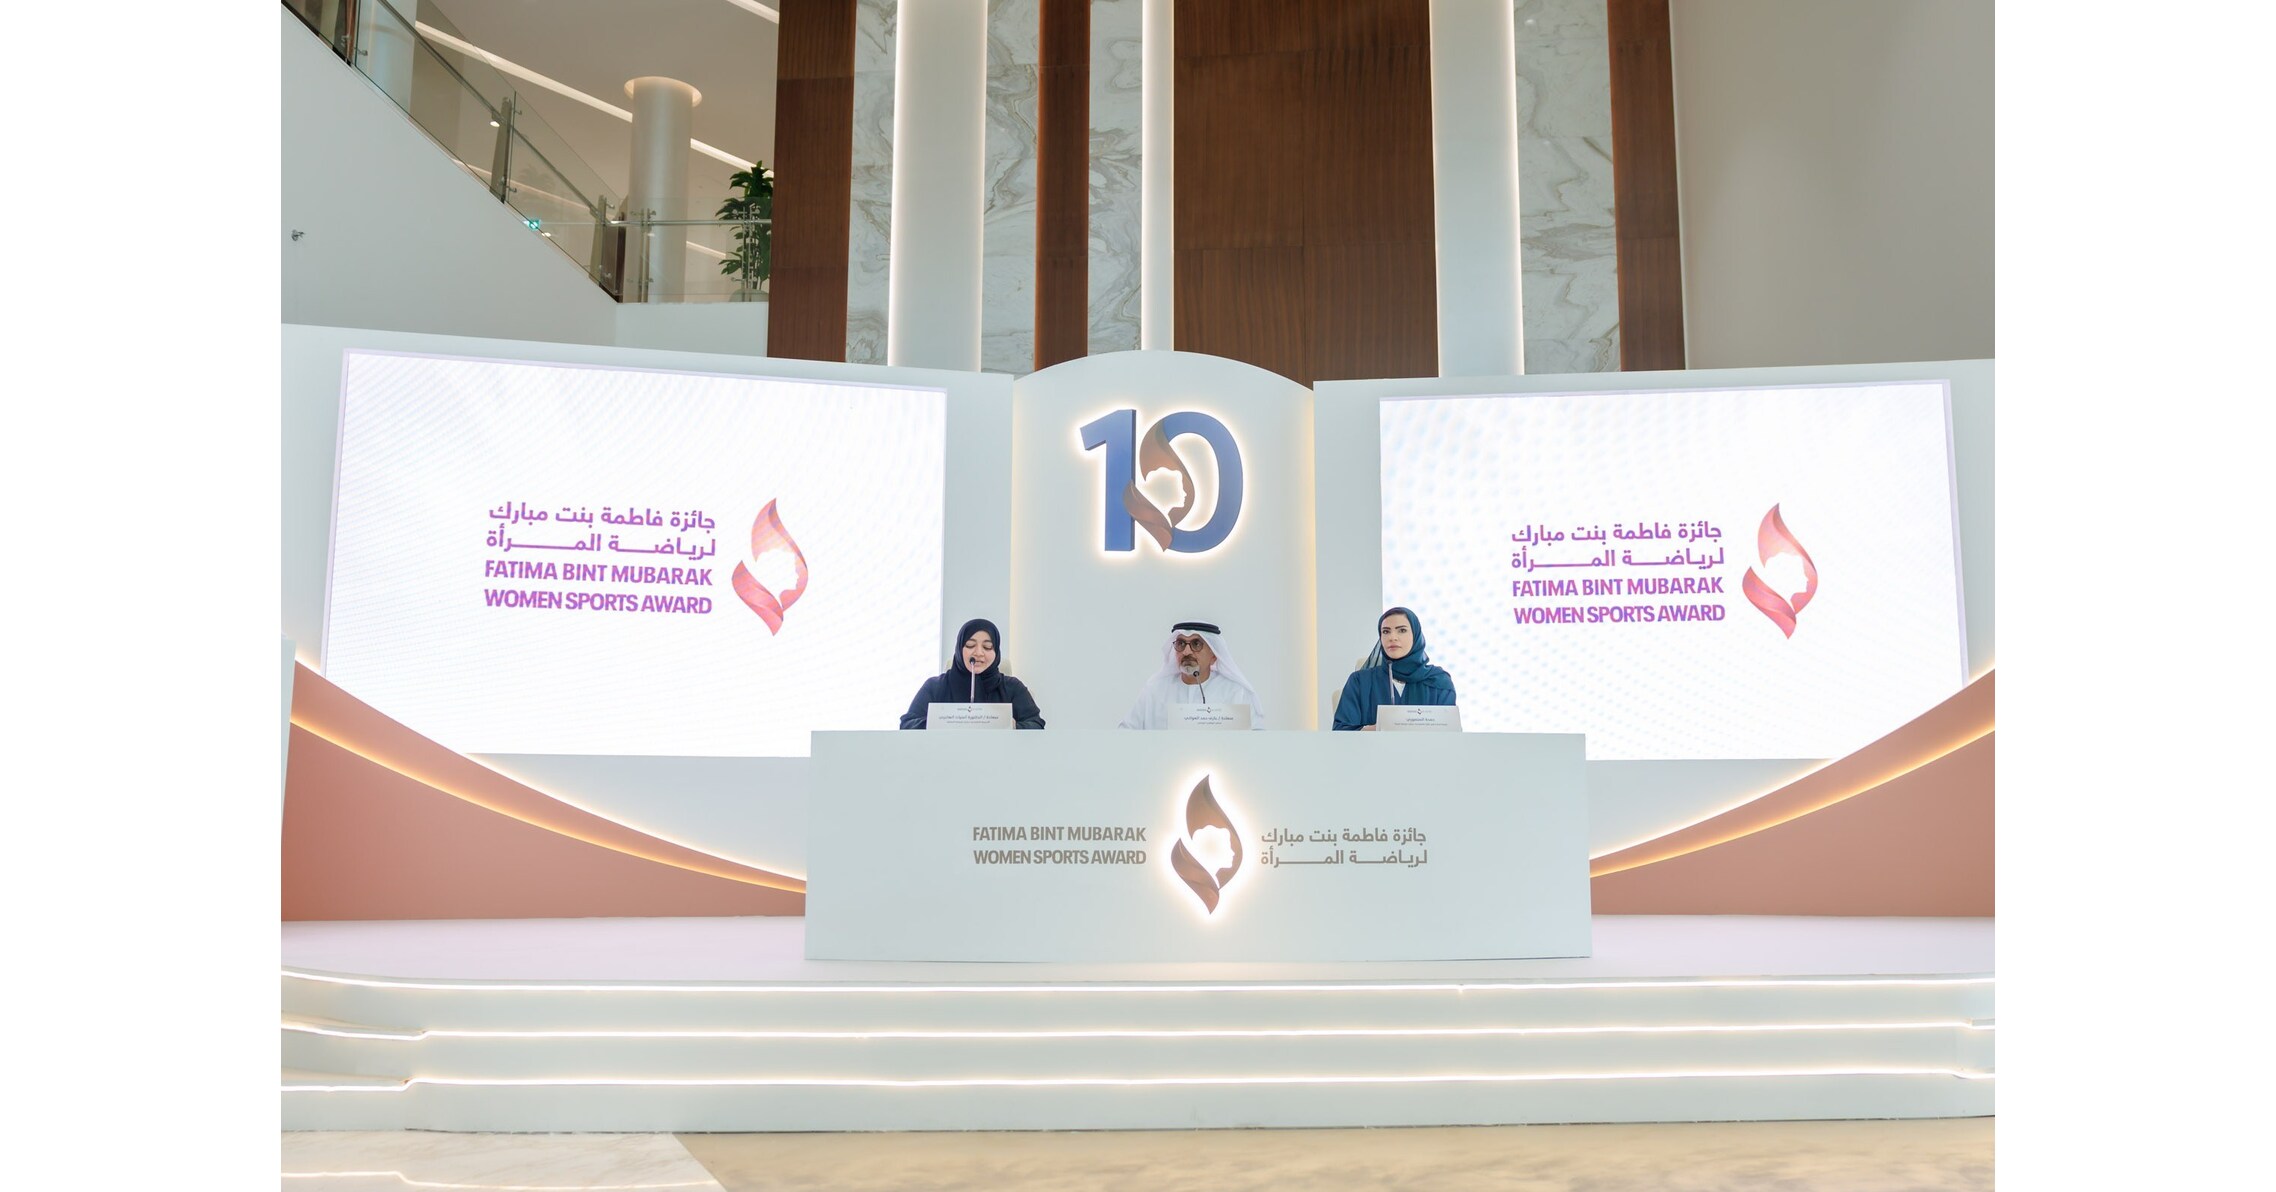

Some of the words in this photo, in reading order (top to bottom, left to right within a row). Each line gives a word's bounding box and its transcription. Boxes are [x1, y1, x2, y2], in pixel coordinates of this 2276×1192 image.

[489, 501, 548, 525] مبارك
[555, 506, 594, 528] بنت
[601, 506, 663, 527] فاطمة
[670, 510, 716, 534] جائزة
[1511, 524, 1565, 547] مبارك
[1571, 526, 1607, 545] بنت
[1613, 522, 1672, 541] فاطمة
[1678, 520, 1722, 544] جائزة
[484, 560, 558, 581] FATIMA
[562, 563, 607, 582] BINT
[611, 564, 713, 587] MUBARAK
[1512, 580, 1579, 598] FATIMA
[1582, 578, 1624, 597] BINT
[1627, 576, 1725, 596] MUBARAK
[484, 589, 563, 610] WOMEN
[565, 591, 639, 613] SPORTS
[640, 594, 713, 615] AWARD
[1513, 606, 1585, 625] WOMEN
[1587, 604, 1656, 624] SPORTS
[1657, 603, 1726, 623] AWARD
[972, 826, 1028, 842] FATIMA
[1030, 826, 1065, 841] BINT
[1067, 826, 1147, 842] MUBARAK
[1261, 828, 1305, 848] مبارك
[1309, 830, 1338, 847] بنت
[1342, 827, 1388, 843] فاطمة
[1393, 826, 1427, 850] جائزة
[973, 849, 1032, 865] WOMEN
[1033, 849, 1090, 865] SPORTS
[1091, 849, 1147, 865] AWARD
